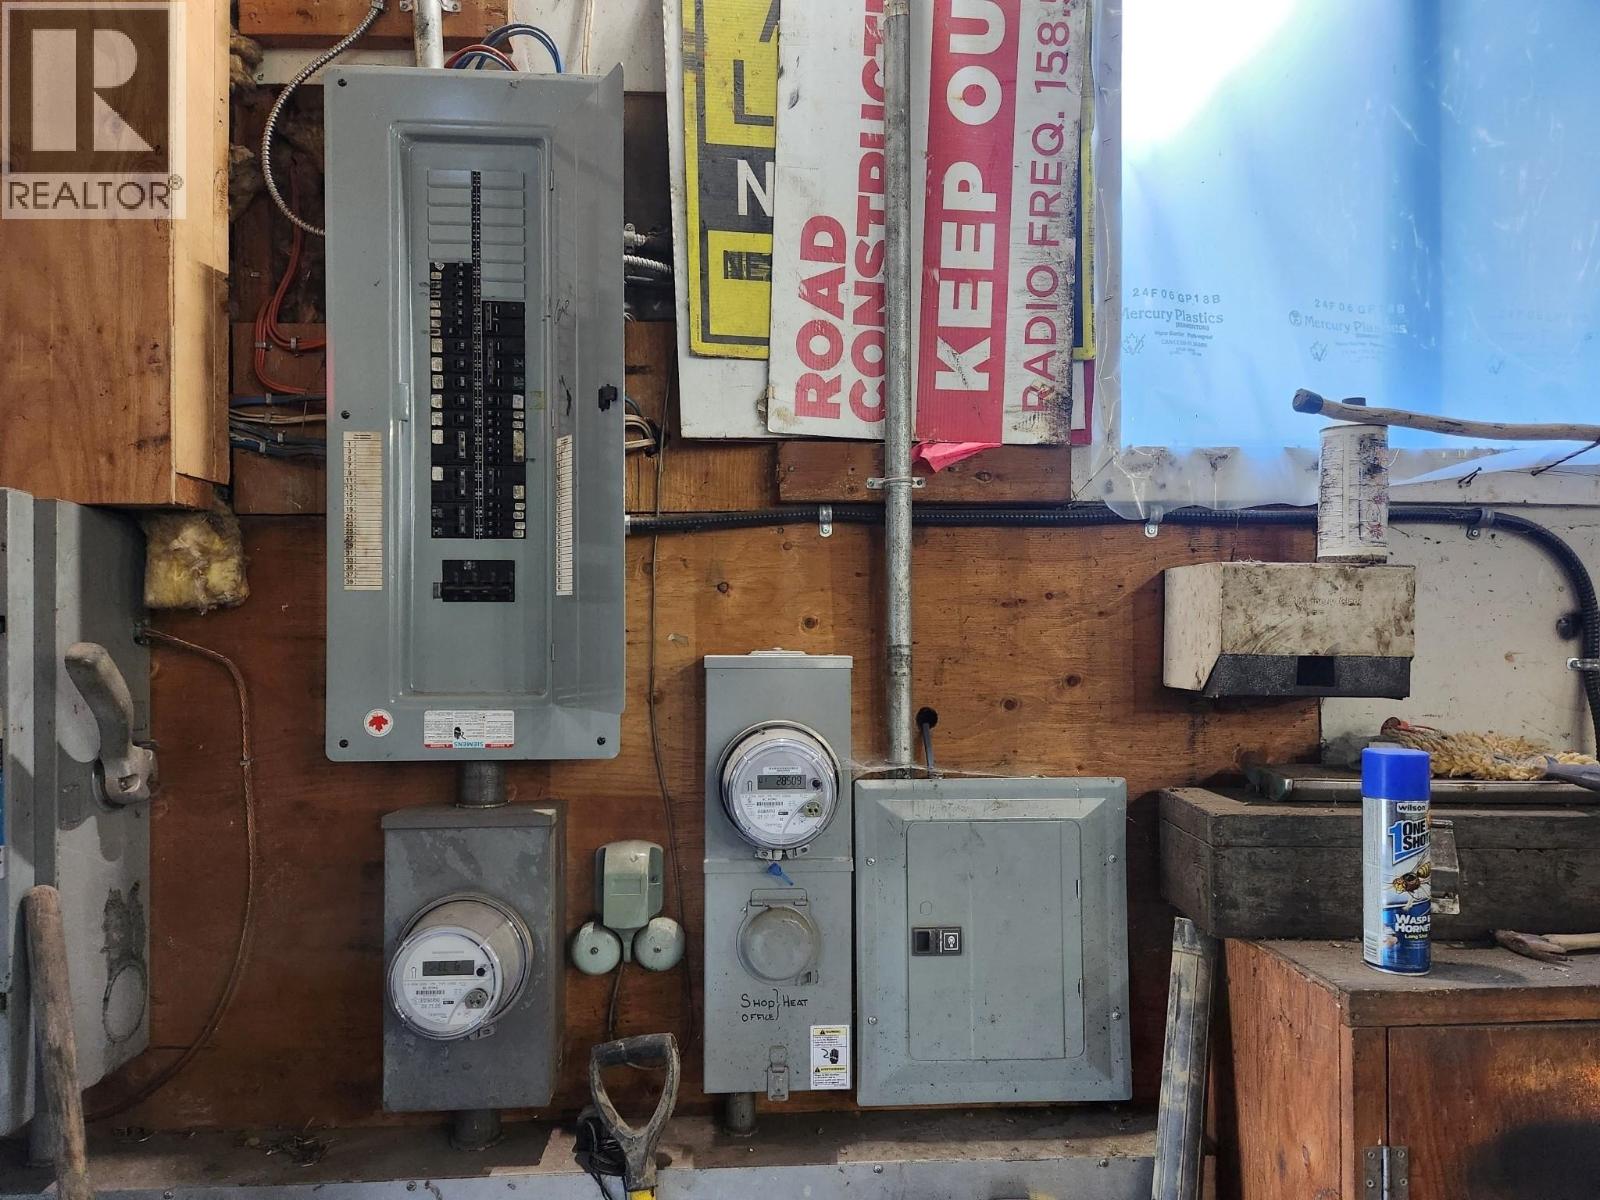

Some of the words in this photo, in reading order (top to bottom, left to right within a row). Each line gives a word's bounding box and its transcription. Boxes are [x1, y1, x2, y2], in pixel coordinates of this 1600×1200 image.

[1034, 0, 1071, 94] 158.
[849, 0, 885, 423] CONSTRUCT
[1028, 110, 1066, 247] FREQ.
[794, 215, 847, 420] ROAD
[934, 160, 998, 392] KEEP
[1174, 308, 1225, 324] Plastics
[1021, 264, 1060, 412] RADIO
[1402, 820, 1426, 836] ONE
[1395, 913, 1427, 924] WASP
[782, 994, 809, 1008] HEAT
